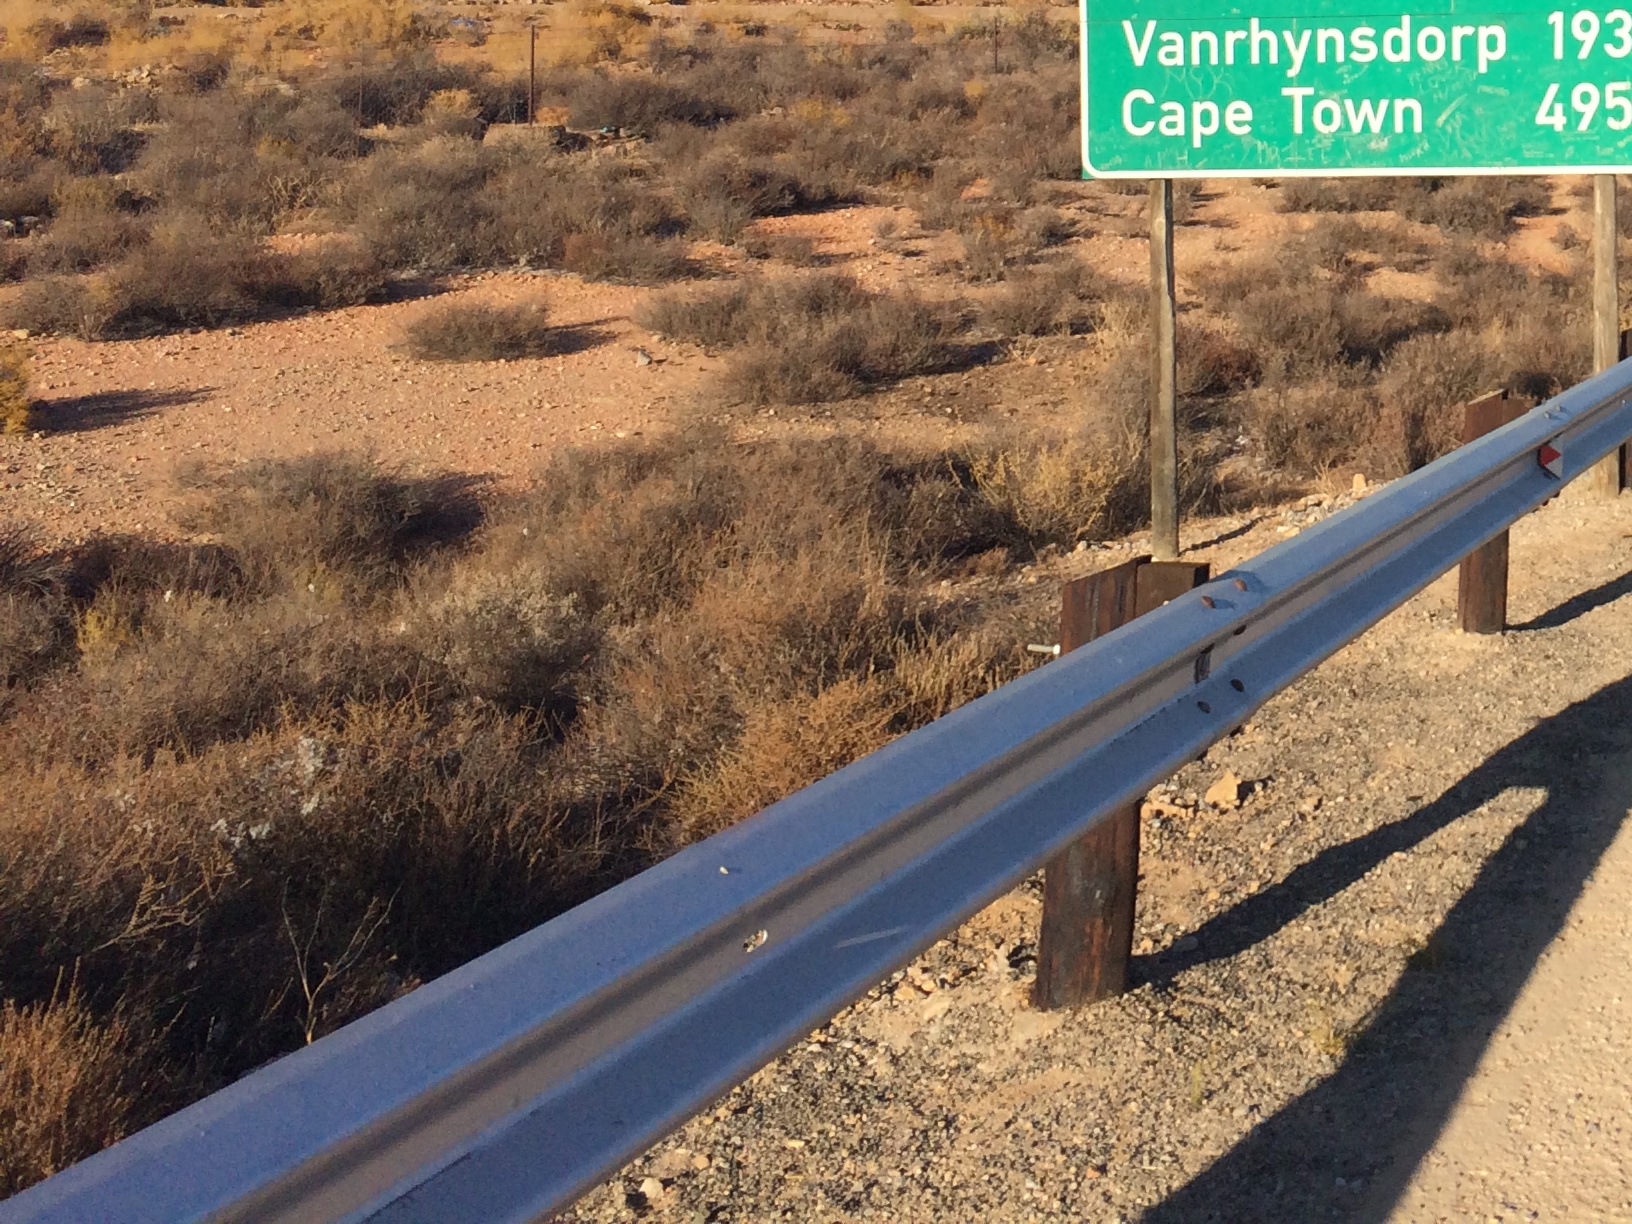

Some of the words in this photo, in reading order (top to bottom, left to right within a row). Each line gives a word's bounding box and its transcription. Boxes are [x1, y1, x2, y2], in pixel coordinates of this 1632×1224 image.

[1122, 15, 1506, 77] Vanrhynsdorp
[1547, 8, 1632, 60] 193
[1121, 88, 1253, 148] Cape
[1281, 86, 1422, 135] Town
